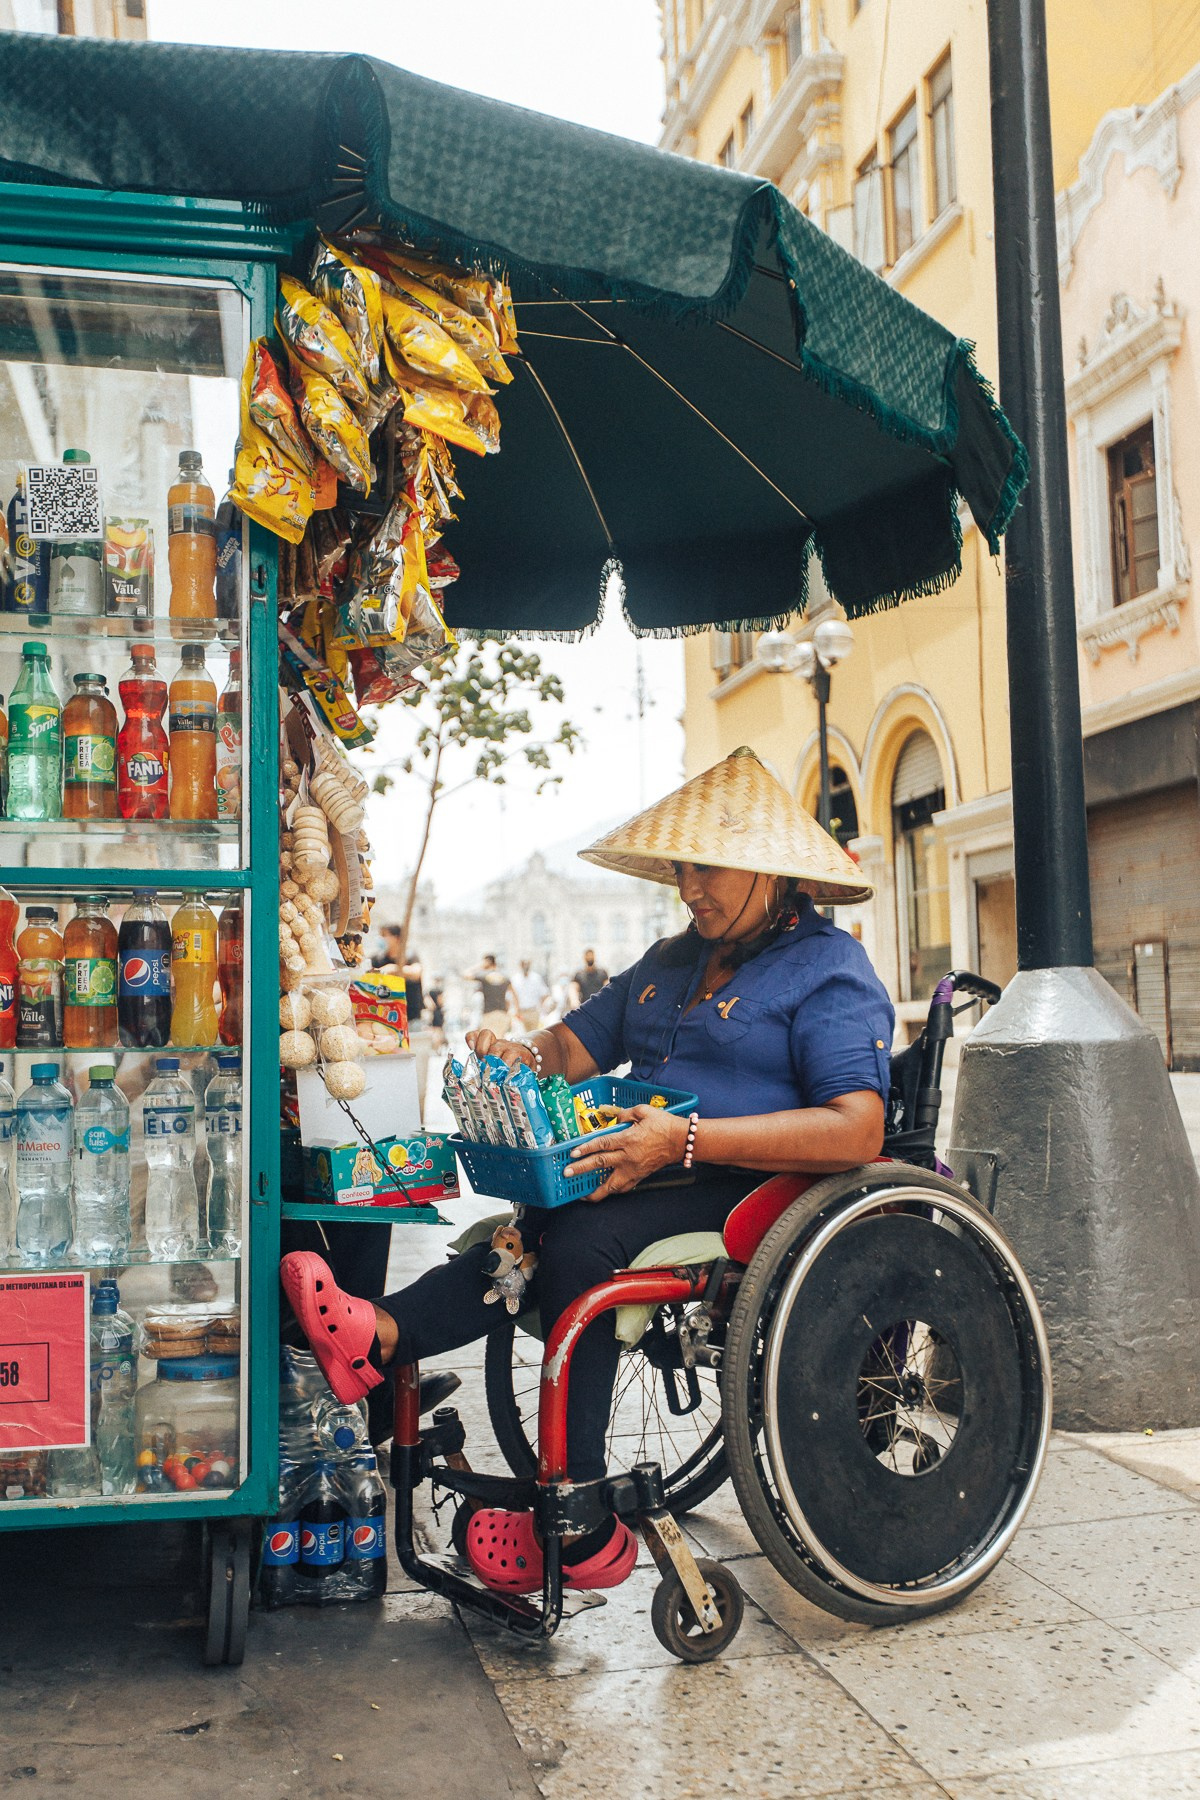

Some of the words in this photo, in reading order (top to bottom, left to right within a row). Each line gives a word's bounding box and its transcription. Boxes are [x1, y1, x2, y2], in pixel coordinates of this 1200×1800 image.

[112, 583, 141, 595] Valle
[28, 715, 58, 739] Sprite
[127, 760, 164, 778] FANTA
[152, 959, 160, 985] pepsi
[0, 985, 14, 1001] NT
[20, 1011, 45, 1022] Valle
[144, 1116, 187, 1134] ELO
[26, 1141, 60, 1151] Mateo
[340, 1190, 371, 1200] Confiteca
[6, 1281, 57, 1290] METROPOLITANA
[318, 1532, 326, 1556] pepsi
